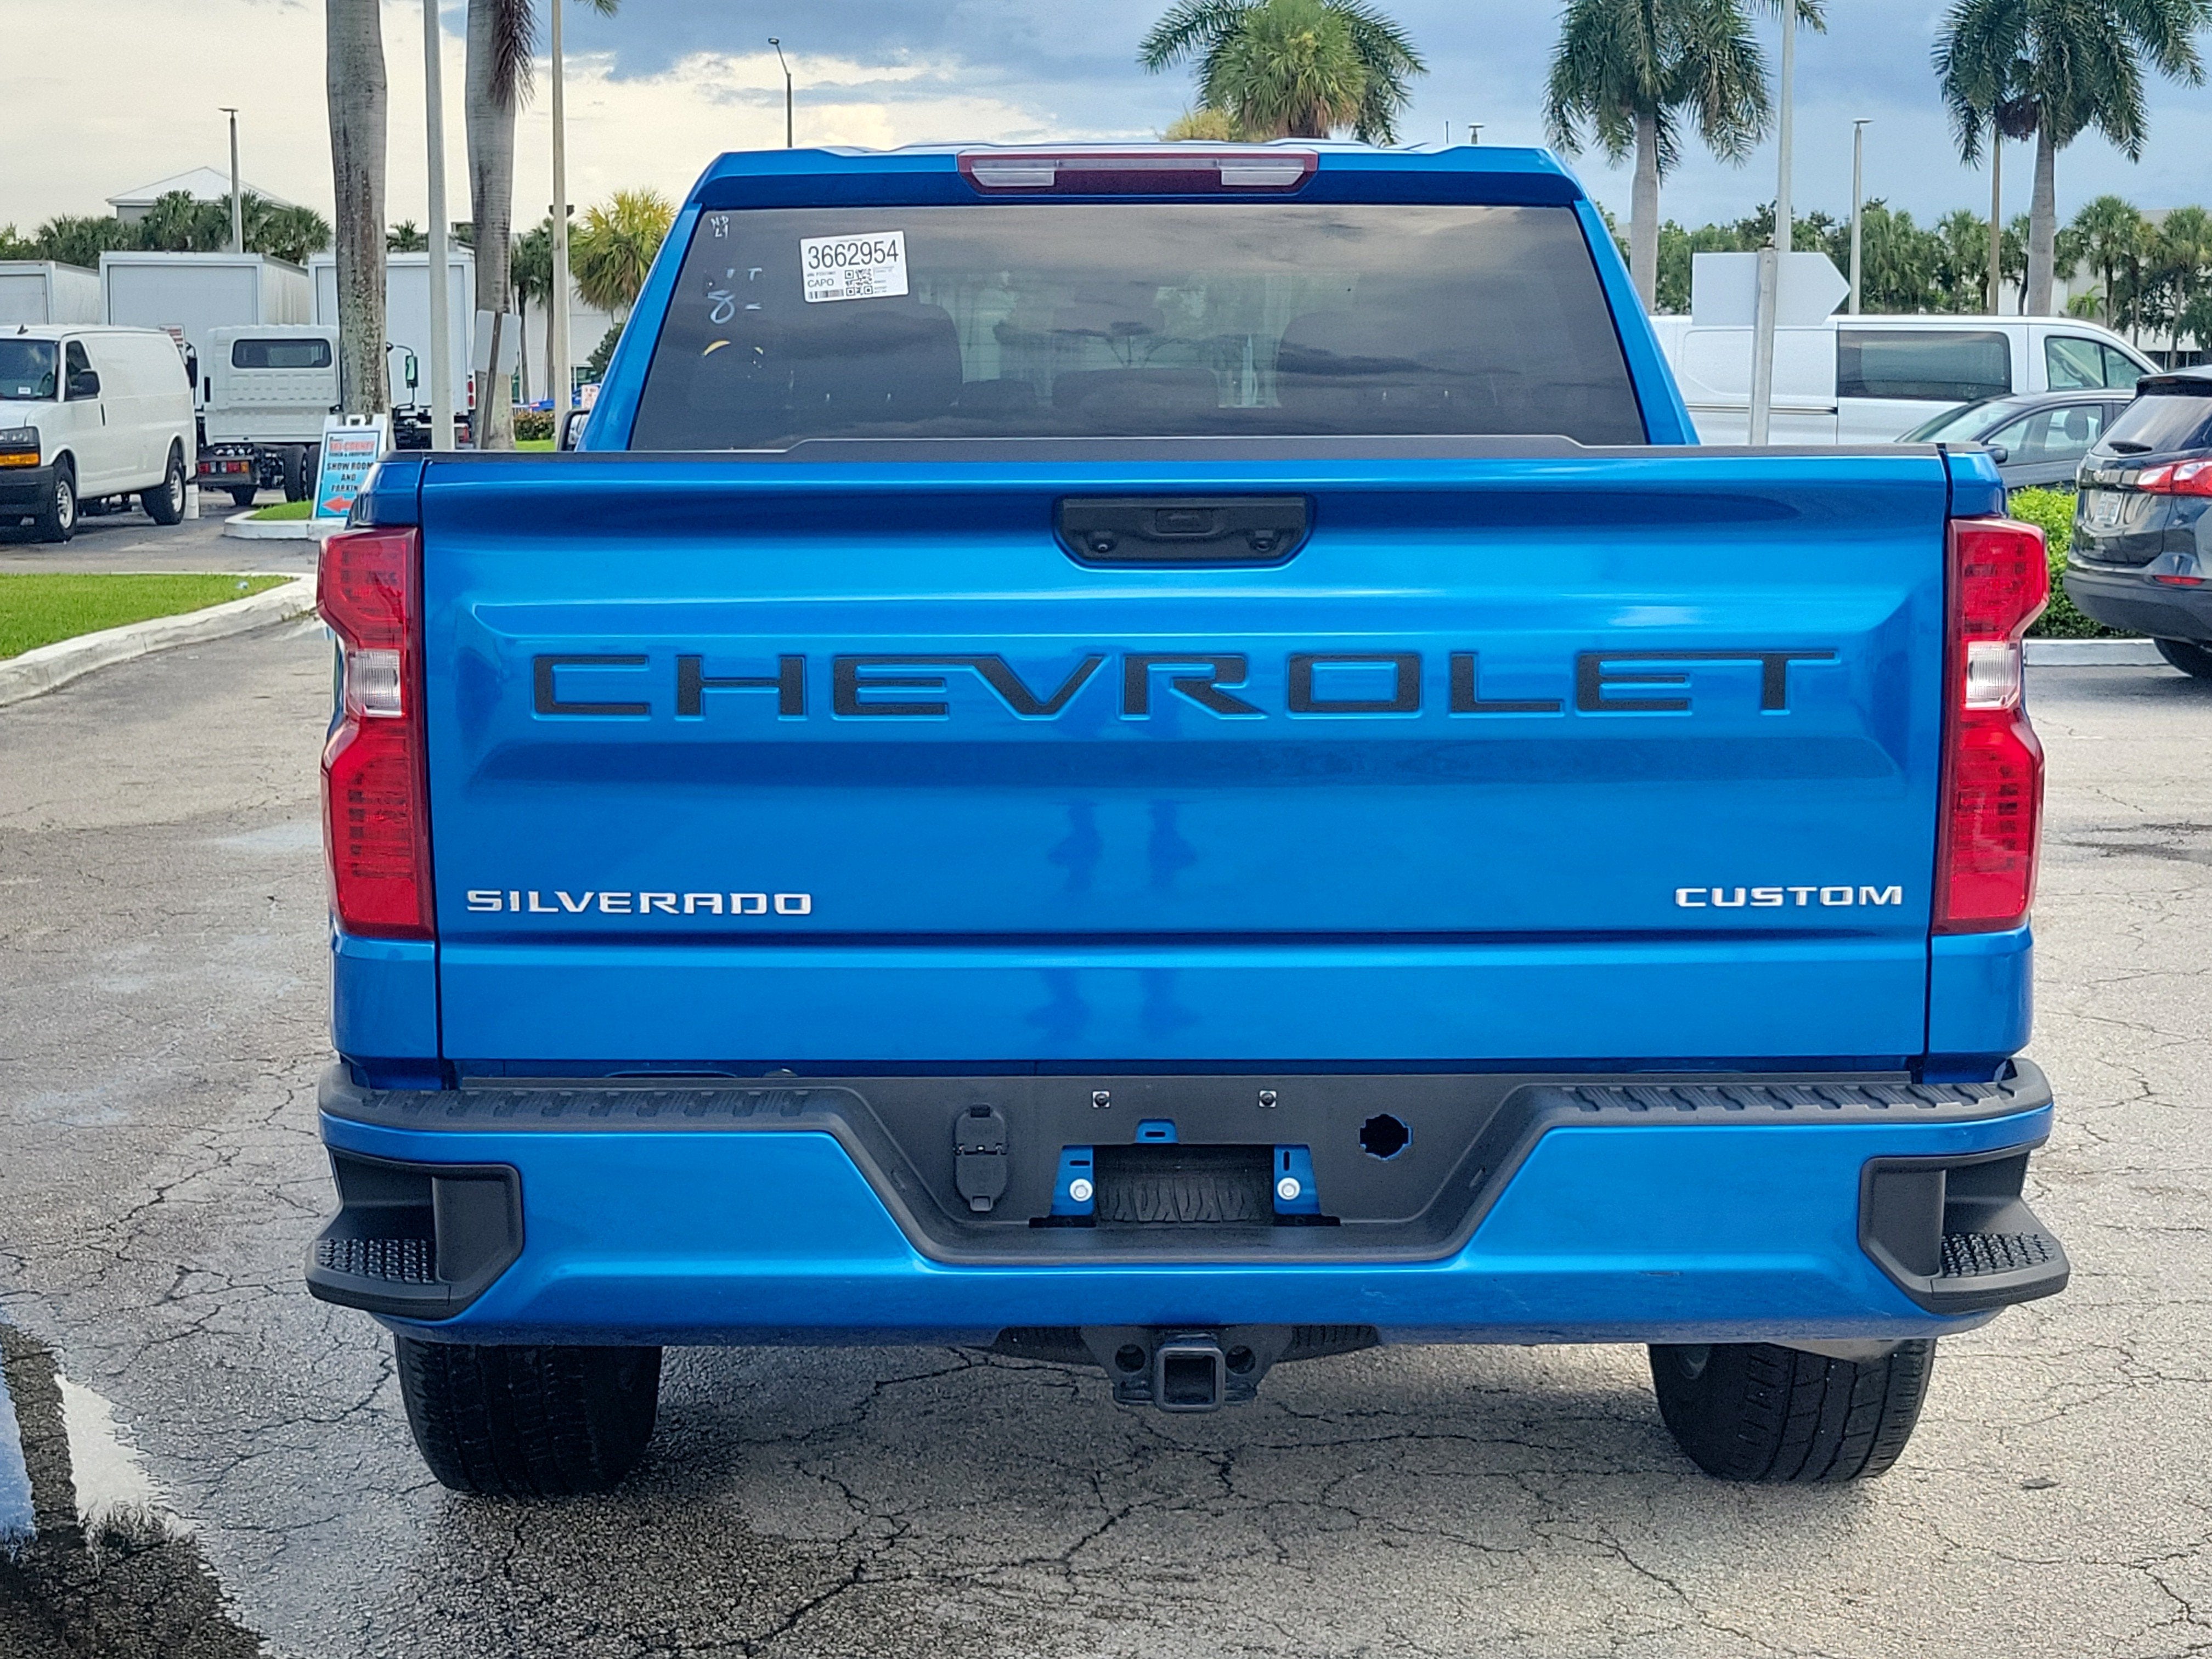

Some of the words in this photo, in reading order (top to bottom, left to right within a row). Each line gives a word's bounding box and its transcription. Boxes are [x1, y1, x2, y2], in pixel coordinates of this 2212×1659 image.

[808, 239, 899, 269] 3662954
[807, 278, 834, 288] CAPO
[327, 462, 349, 471] SHOW
[341, 473, 356, 482] AND
[331, 484, 358, 493] PARKIN
[533, 651, 1839, 721] CHEVROLET
[466, 890, 812, 915] SILVERADO
[1675, 885, 1903, 907] CUSTOM
